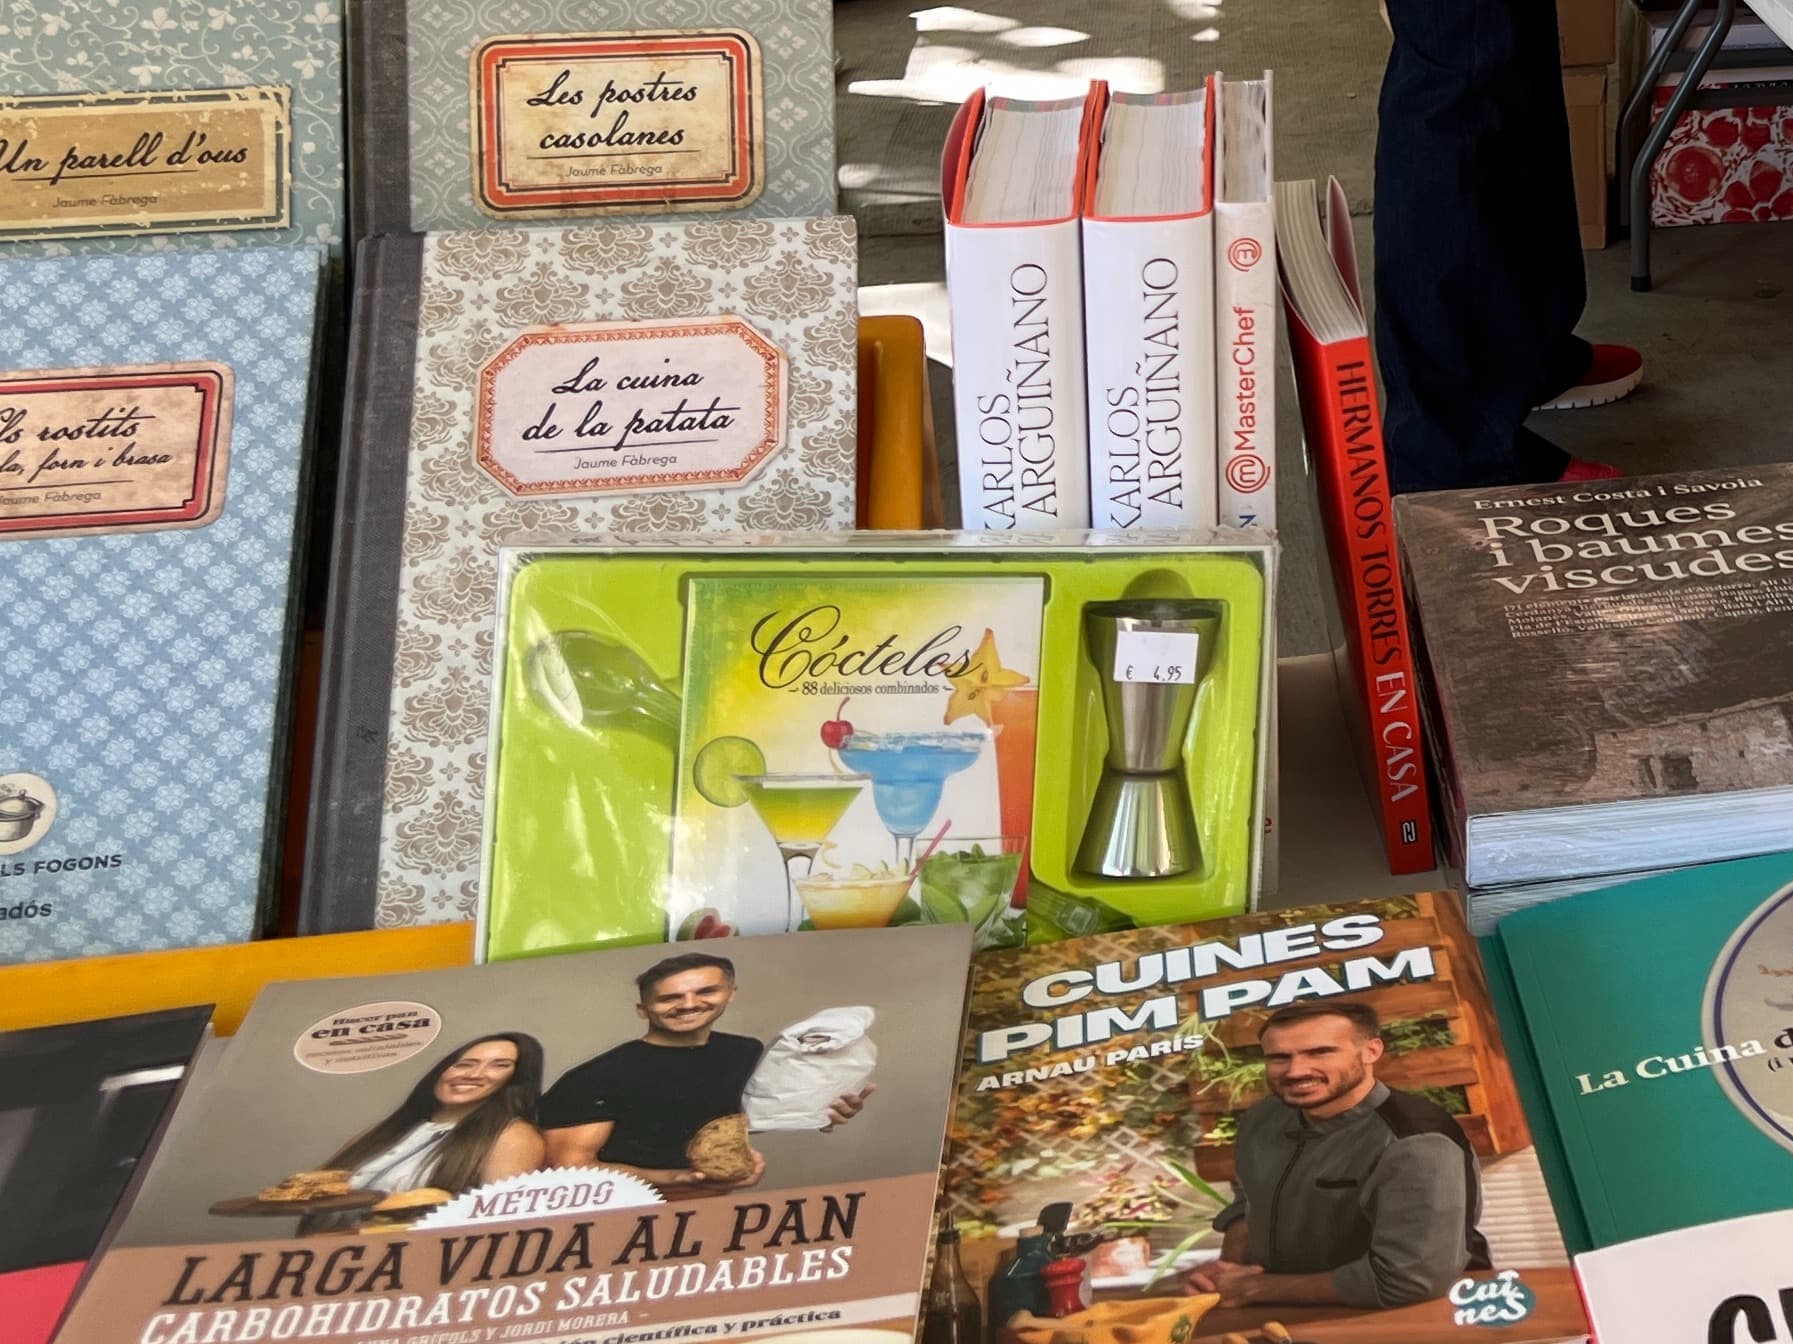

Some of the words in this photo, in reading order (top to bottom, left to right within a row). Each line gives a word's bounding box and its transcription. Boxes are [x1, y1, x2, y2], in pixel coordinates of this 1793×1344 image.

[526, 69, 584, 107] Les
[590, 71, 699, 119] postres
[539, 110, 685, 150] casolanes
[0, 139, 49, 173] Un
[49, 131, 163, 186] parell
[166, 130, 248, 165] d'ous
[565, 164, 607, 178] Jaume
[610, 161, 663, 178] Fàbrega
[551, 356, 607, 394] La
[616, 358, 704, 390] cuina
[1006, 264, 1058, 517] ARGUIÑANO
[1231, 307, 1257, 451] MasterChef
[521, 402, 564, 441] de
[574, 400, 614, 438] la
[611, 397, 741, 452] patata
[1336, 360, 1389, 539] HERMANOS
[978, 393, 1016, 531] KARLOS
[1474, 494, 1566, 510] Ernest
[1573, 489, 1650, 505] Costa
[1658, 486, 1667, 497] i
[1673, 477, 1764, 496] Savoia
[1479, 502, 1737, 539] Roques
[1490, 542, 1514, 568] i
[1360, 550, 1402, 666] TORRES
[750, 605, 984, 690] Cócteles
[1125, 665, 1133, 681] €
[1153, 664, 1183, 682] 4.95
[802, 682, 818, 696] 88
[819, 681, 873, 696] deliciosos
[874, 680, 940, 696] combinados
[1376, 671, 1408, 713] EN
[1381, 721, 1419, 804] CASA
[33, 854, 122, 875] FOGONS
[1020, 913, 1385, 1009] CUINES
[312, 1027, 350, 1039] en
[359, 1018, 431, 1035] casa
[977, 993, 1179, 1064] PIM
[1202, 946, 1437, 1021] PAM
[1576, 1068, 1629, 1096] La
[1635, 1039, 1767, 1081] Cuina
[1766, 1054, 1783, 1073] (i
[161, 1241, 409, 1307] LARGA
[439, 1221, 596, 1287] VIDA
[612, 1210, 703, 1265] AL
[722, 1190, 867, 1254] PAN
[140, 1281, 549, 1344] CARBOHIDRATOS
[556, 1244, 854, 1313] SALUDABLES
[500, 1320, 554, 1340] JORDI
[557, 1311, 630, 1333] MORERA
